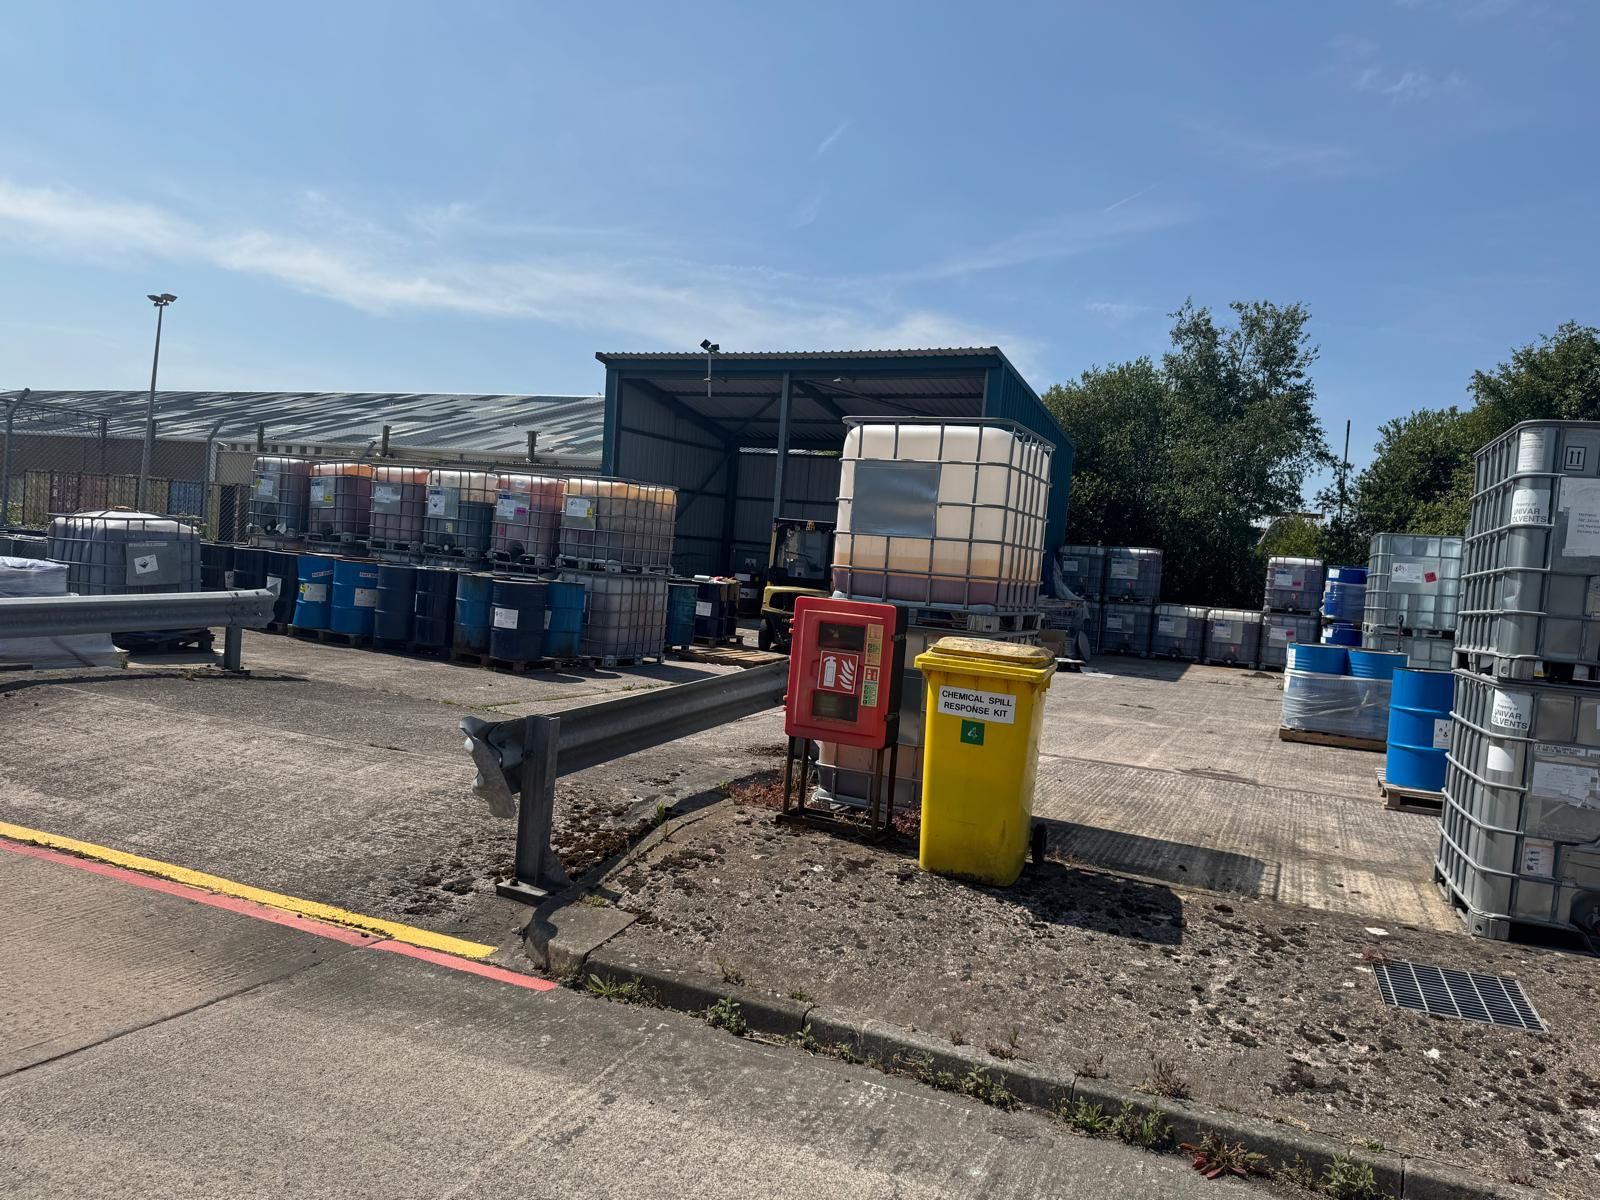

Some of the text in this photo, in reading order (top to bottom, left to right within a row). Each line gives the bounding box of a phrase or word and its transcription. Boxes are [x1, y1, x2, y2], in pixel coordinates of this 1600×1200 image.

[942, 690, 1012, 707] CHEMICAL SPILL
[943, 702, 1008, 717] RESPONSE KIT
[967, 727, 978, 738] 4
